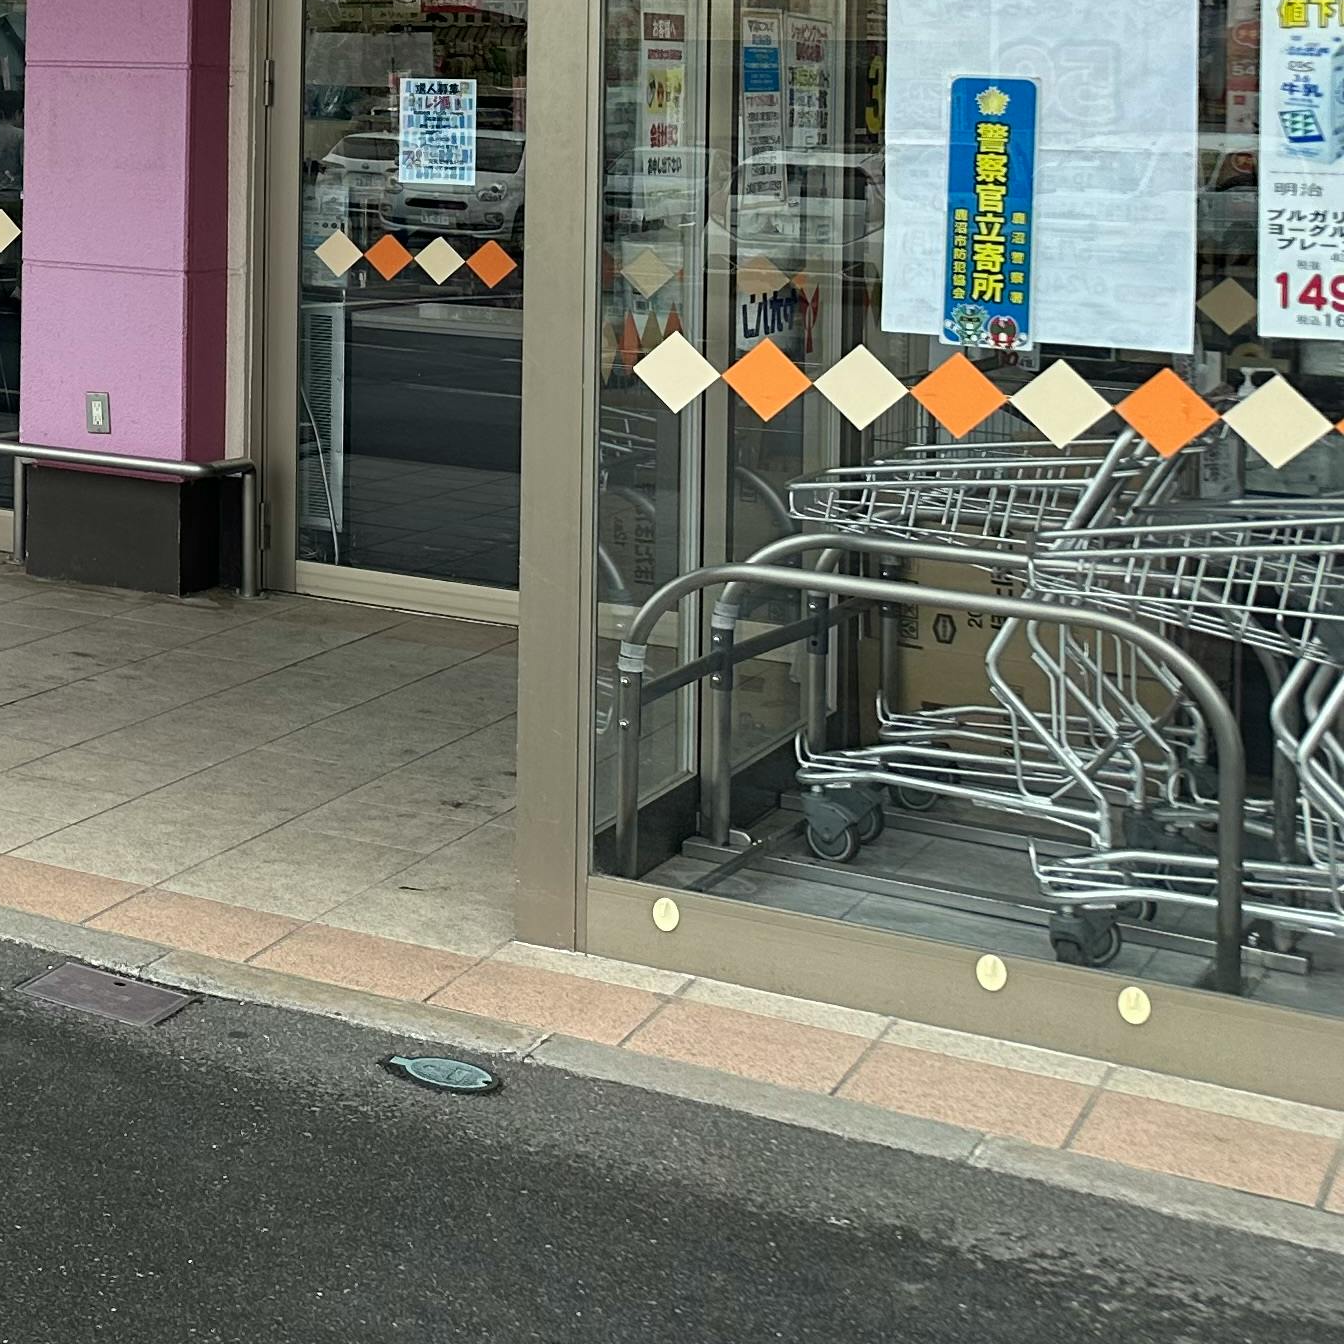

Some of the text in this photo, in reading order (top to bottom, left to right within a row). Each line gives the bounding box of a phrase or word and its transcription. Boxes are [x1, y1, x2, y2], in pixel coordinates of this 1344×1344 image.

[415, 83, 461, 95] 求人募集
[1273, 182, 1324, 197] 明治
[971, 122, 1010, 303] 警察官立寄所
[1277, 237, 1344, 254] プレー
[1275, 272, 1344, 314] 149
